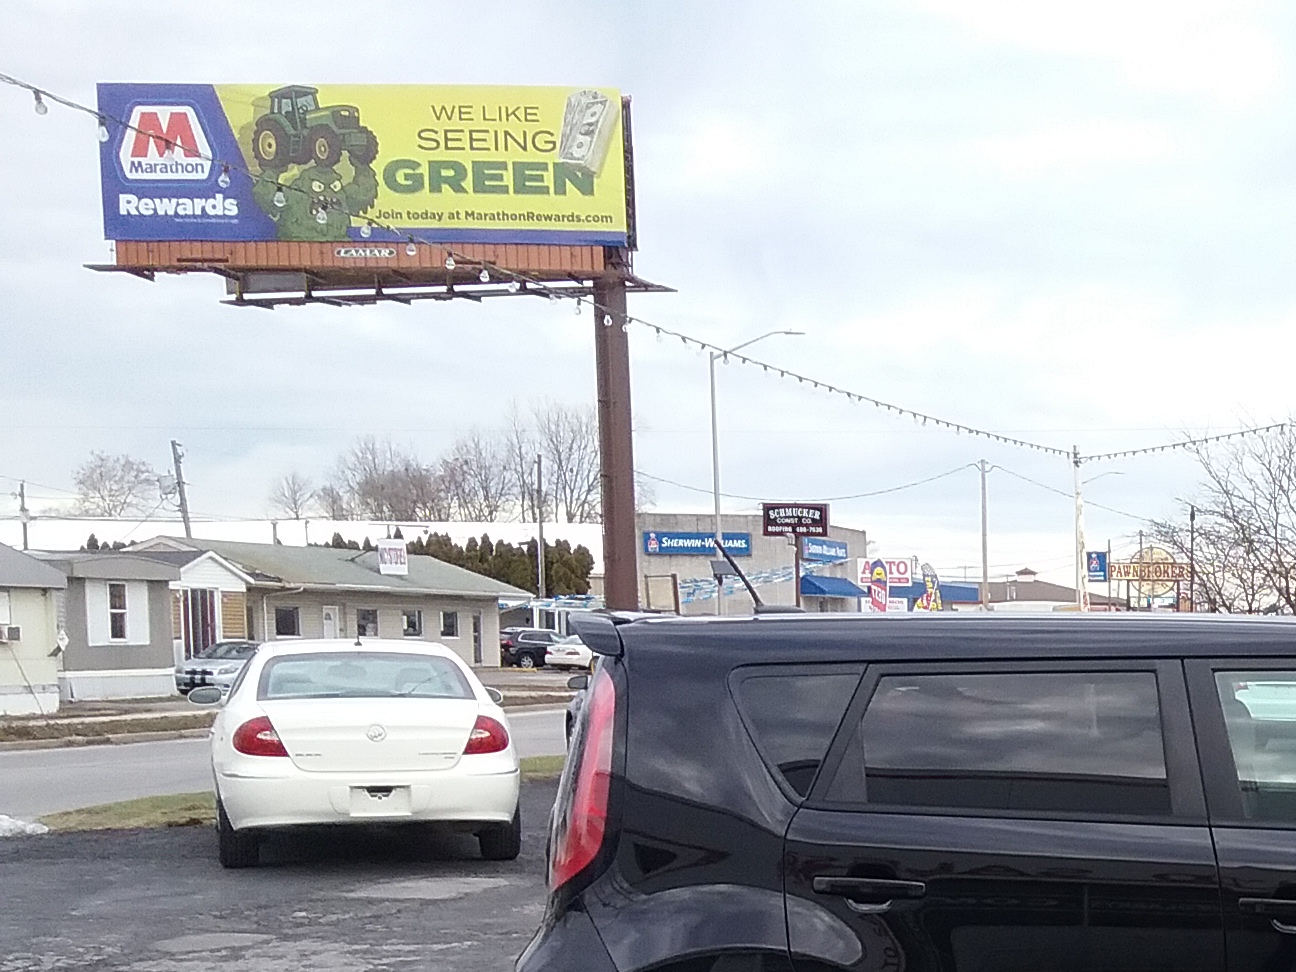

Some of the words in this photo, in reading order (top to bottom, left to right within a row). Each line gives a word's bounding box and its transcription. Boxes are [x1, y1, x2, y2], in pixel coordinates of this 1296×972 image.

[431, 104, 474, 121] WE
[482, 105, 540, 123] LIKE
[417, 128, 557, 152] SEEING
[129, 161, 205, 174] Marathon
[382, 159, 595, 196] GREEN
[119, 193, 239, 216] Rewards
[375, 208, 403, 221] Join
[406, 209, 444, 224] today
[448, 210, 461, 221] at
[464, 209, 613, 224] MarathonRewards.com
[340, 249, 390, 257] LAMAR
[768, 507, 821, 520] SCHMUCKER
[661, 536, 748, 549] SHERWIN-WLIAMS.
[861, 560, 908, 576] ATO
